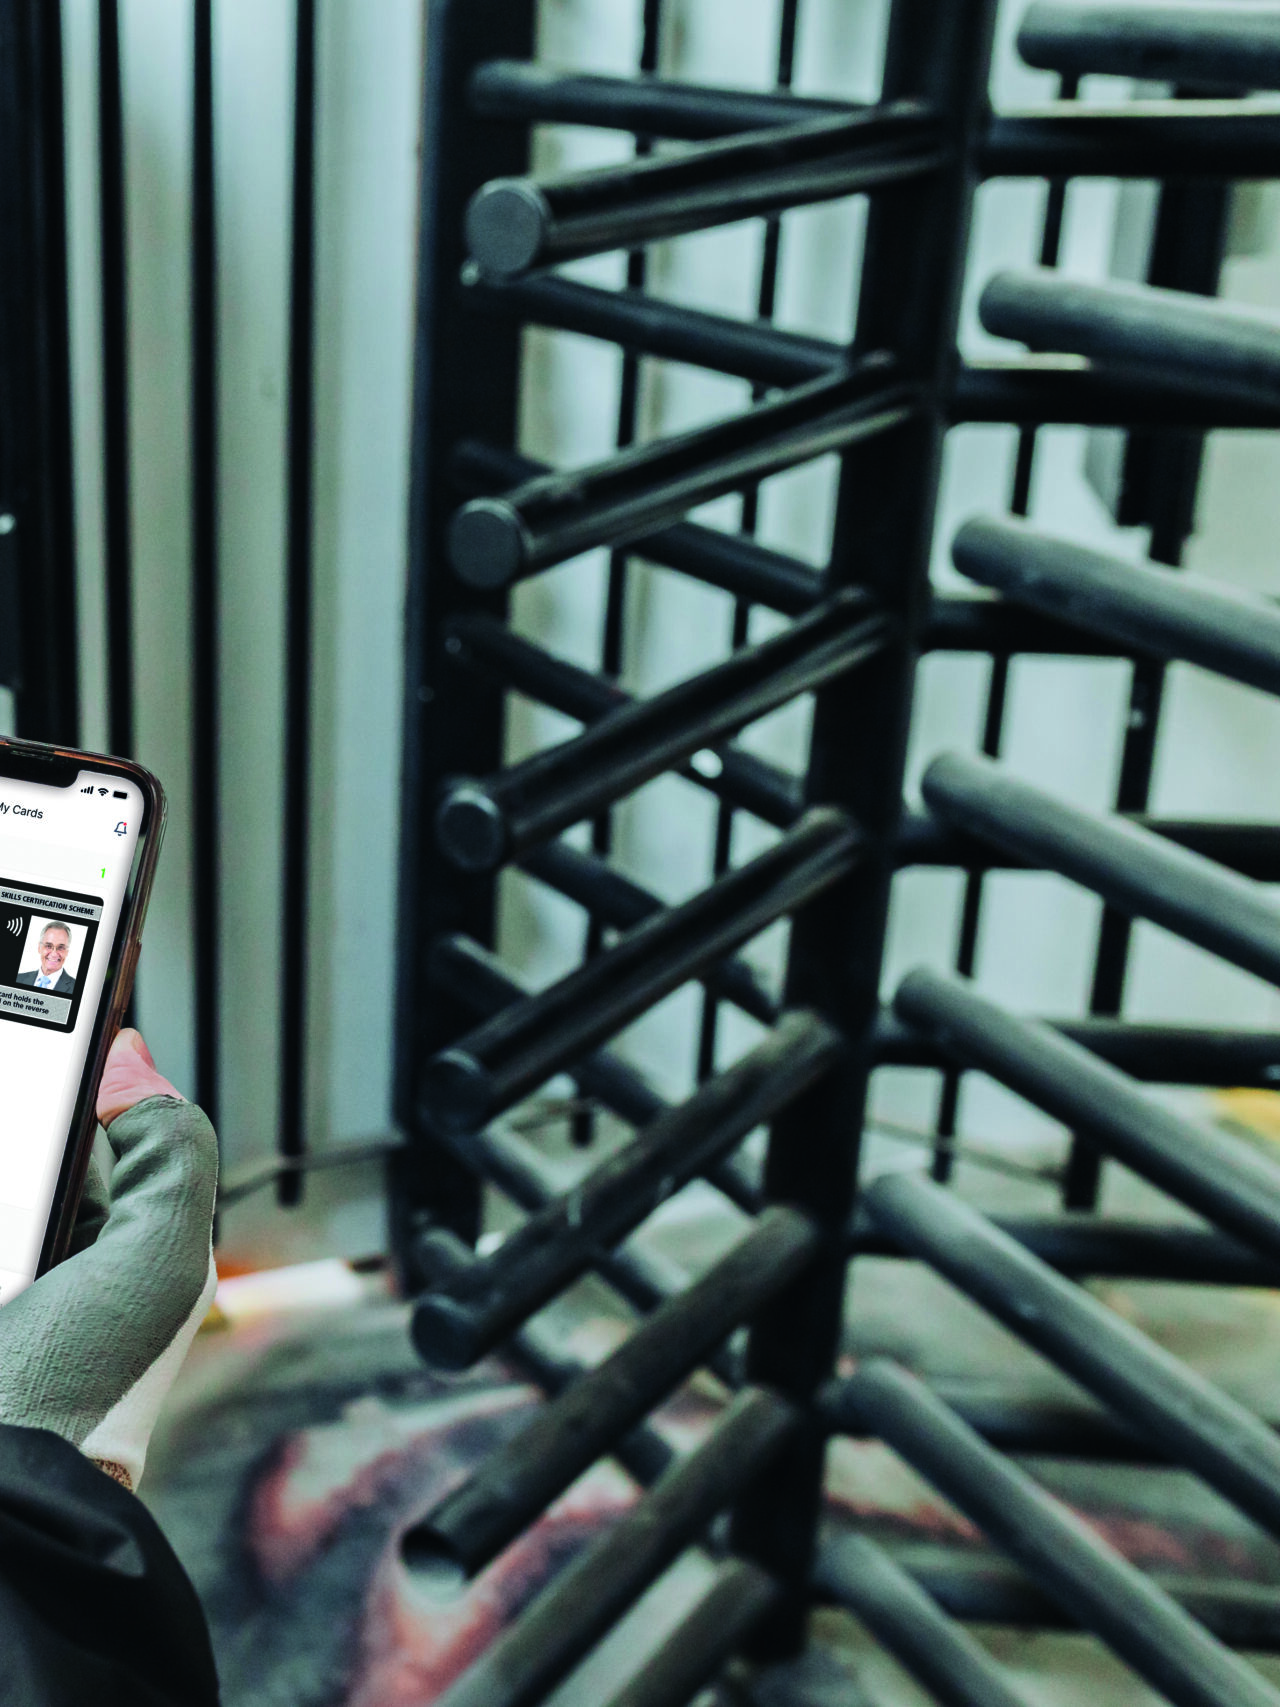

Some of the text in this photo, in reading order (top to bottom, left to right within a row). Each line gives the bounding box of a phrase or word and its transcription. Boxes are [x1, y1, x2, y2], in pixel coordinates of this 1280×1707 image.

[12, 804, 44, 819] Cards
[0, 891, 21, 901] SKILLS
[22, 895, 68, 911] CERTIFICATION
[69, 904, 95, 916] SCHEME
[13, 994, 32, 1003] holds
[32, 998, 44, 1006] the
[12, 1001, 24, 1009] the
[25, 1005, 49, 1015] reverse
